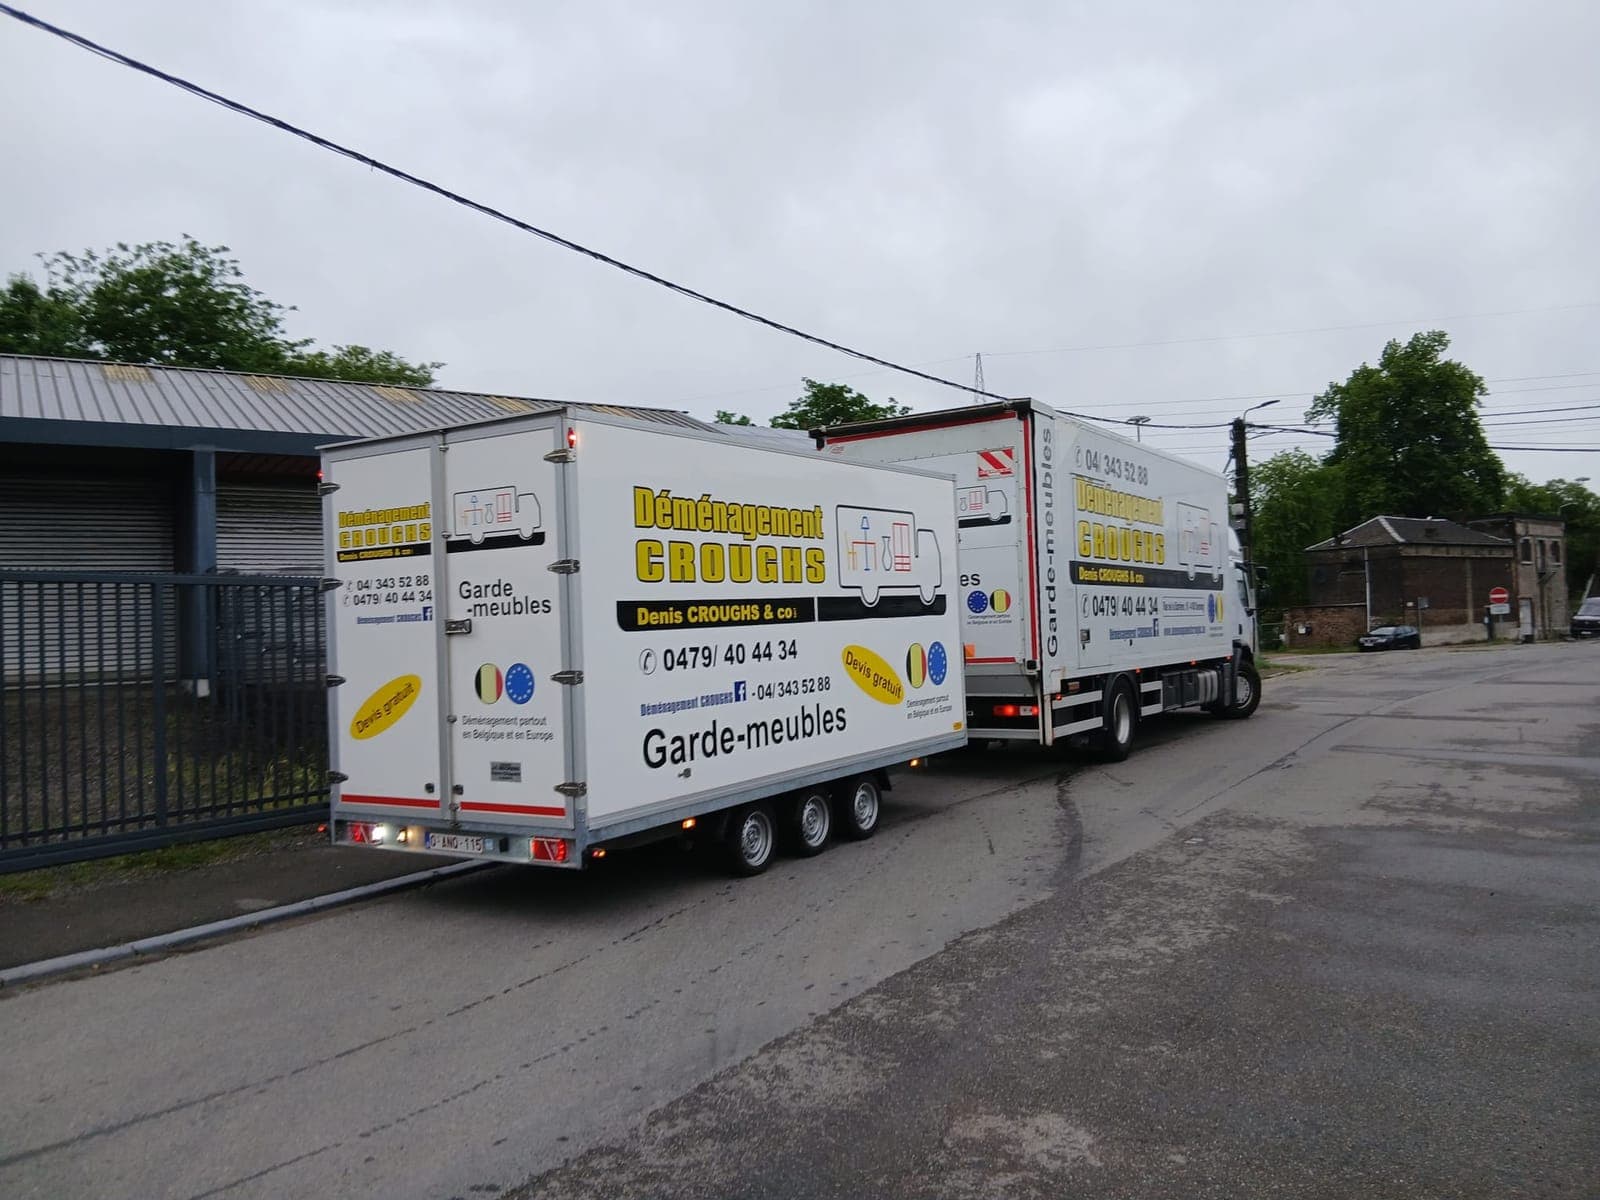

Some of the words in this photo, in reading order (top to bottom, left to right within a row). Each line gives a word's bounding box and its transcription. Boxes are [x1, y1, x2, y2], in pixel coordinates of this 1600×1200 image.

[1104, 455, 1121, 478] 343
[1124, 461, 1135, 482] 52
[1138, 465, 1148, 486] 88
[339, 501, 431, 528] Déménagement
[633, 486, 824, 541] Déménagement
[339, 523, 431, 548] CROUGHS
[1042, 428, 1058, 658] Garde-meubles
[1078, 520, 1165, 565] CROUGHS
[635, 539, 826, 584] CROUGHS
[376, 578, 395, 589] 343
[399, 576, 412, 588] 52
[415, 575, 429, 586] 88
[459, 578, 513, 599] Garde
[385, 592, 398, 604] 40
[402, 591, 415, 602] 44
[419, 590, 432, 602] 34
[467, 596, 551, 617] -meubles
[1122, 596, 1133, 616] 40
[1136, 596, 1146, 616] 44
[1148, 597, 1158, 615] 34
[637, 607, 683, 626] Denis
[687, 604, 760, 623] CROUGHS
[764, 604, 774, 619] &
[663, 645, 718, 671] 0479/
[724, 643, 745, 665] 40
[752, 641, 772, 662] 44
[778, 639, 798, 660] 34
[778, 680, 799, 697] 343
[802, 678, 815, 694] 52
[817, 676, 831, 692] 88
[846, 650, 871, 679] Devis
[873, 672, 901, 699] gratuit
[356, 709, 382, 733] Devis
[383, 682, 414, 715] gratuit
[520, 716, 547, 727] partout
[463, 731, 472, 739] en
[473, 729, 505, 742] Belgique
[506, 731, 514, 739] et
[515, 731, 524, 739] en
[526, 730, 554, 742] Europe
[642, 703, 847, 769] Garde-meubles
